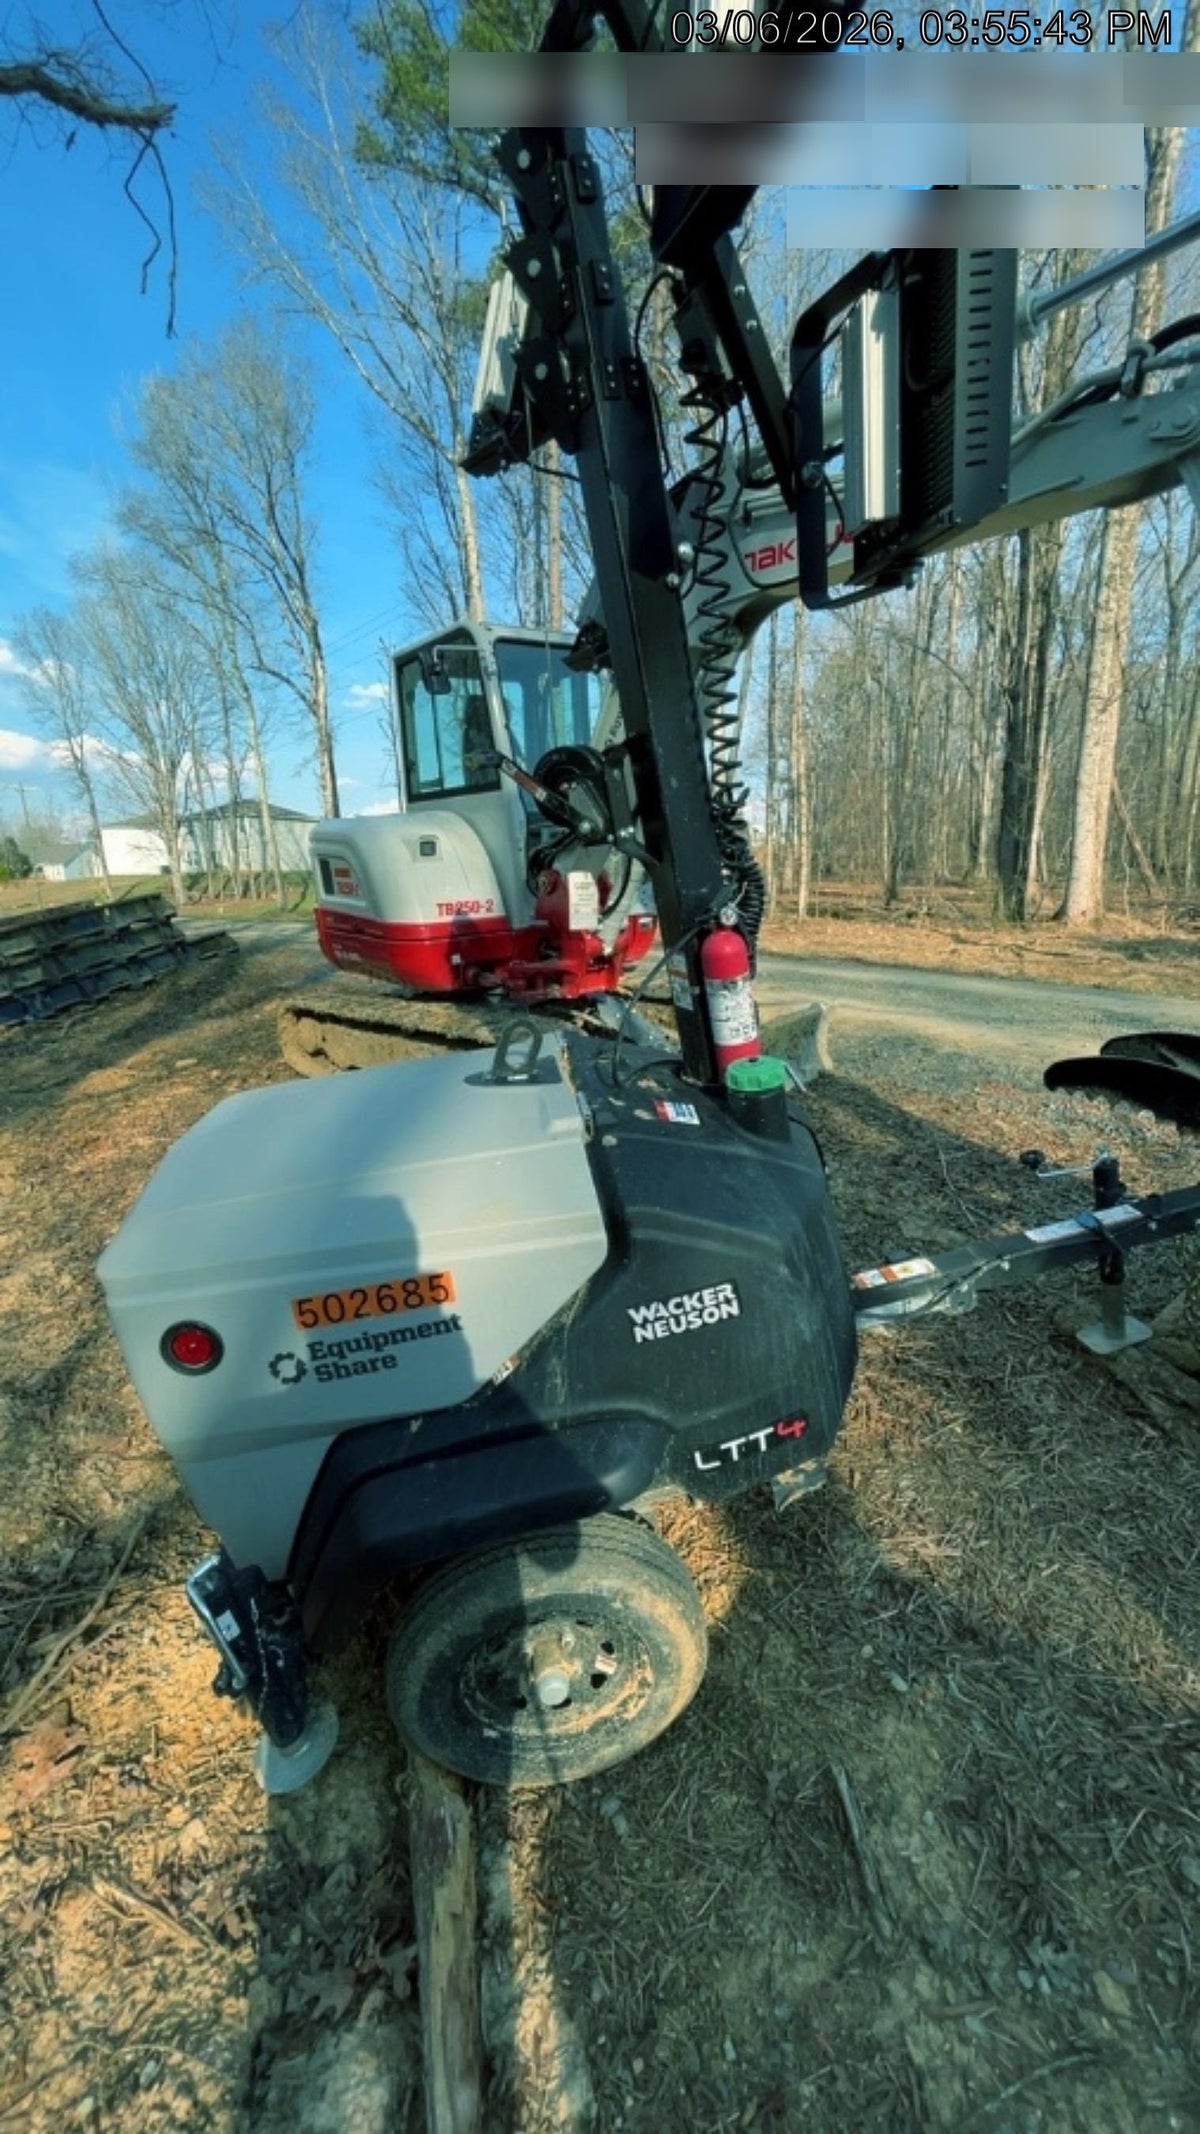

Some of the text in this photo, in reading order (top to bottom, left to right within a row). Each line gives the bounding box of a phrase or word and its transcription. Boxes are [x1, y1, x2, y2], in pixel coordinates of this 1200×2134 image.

[436, 898, 494, 917] TB250-2
[296, 1272, 451, 1329] 502685
[627, 1283, 737, 1325] WACKER
[632, 1298, 741, 1344] NEUSON
[306, 1313, 464, 1362] Equipment
[314, 1353, 398, 1384] Share
[693, 1417, 806, 1471] LTT4
